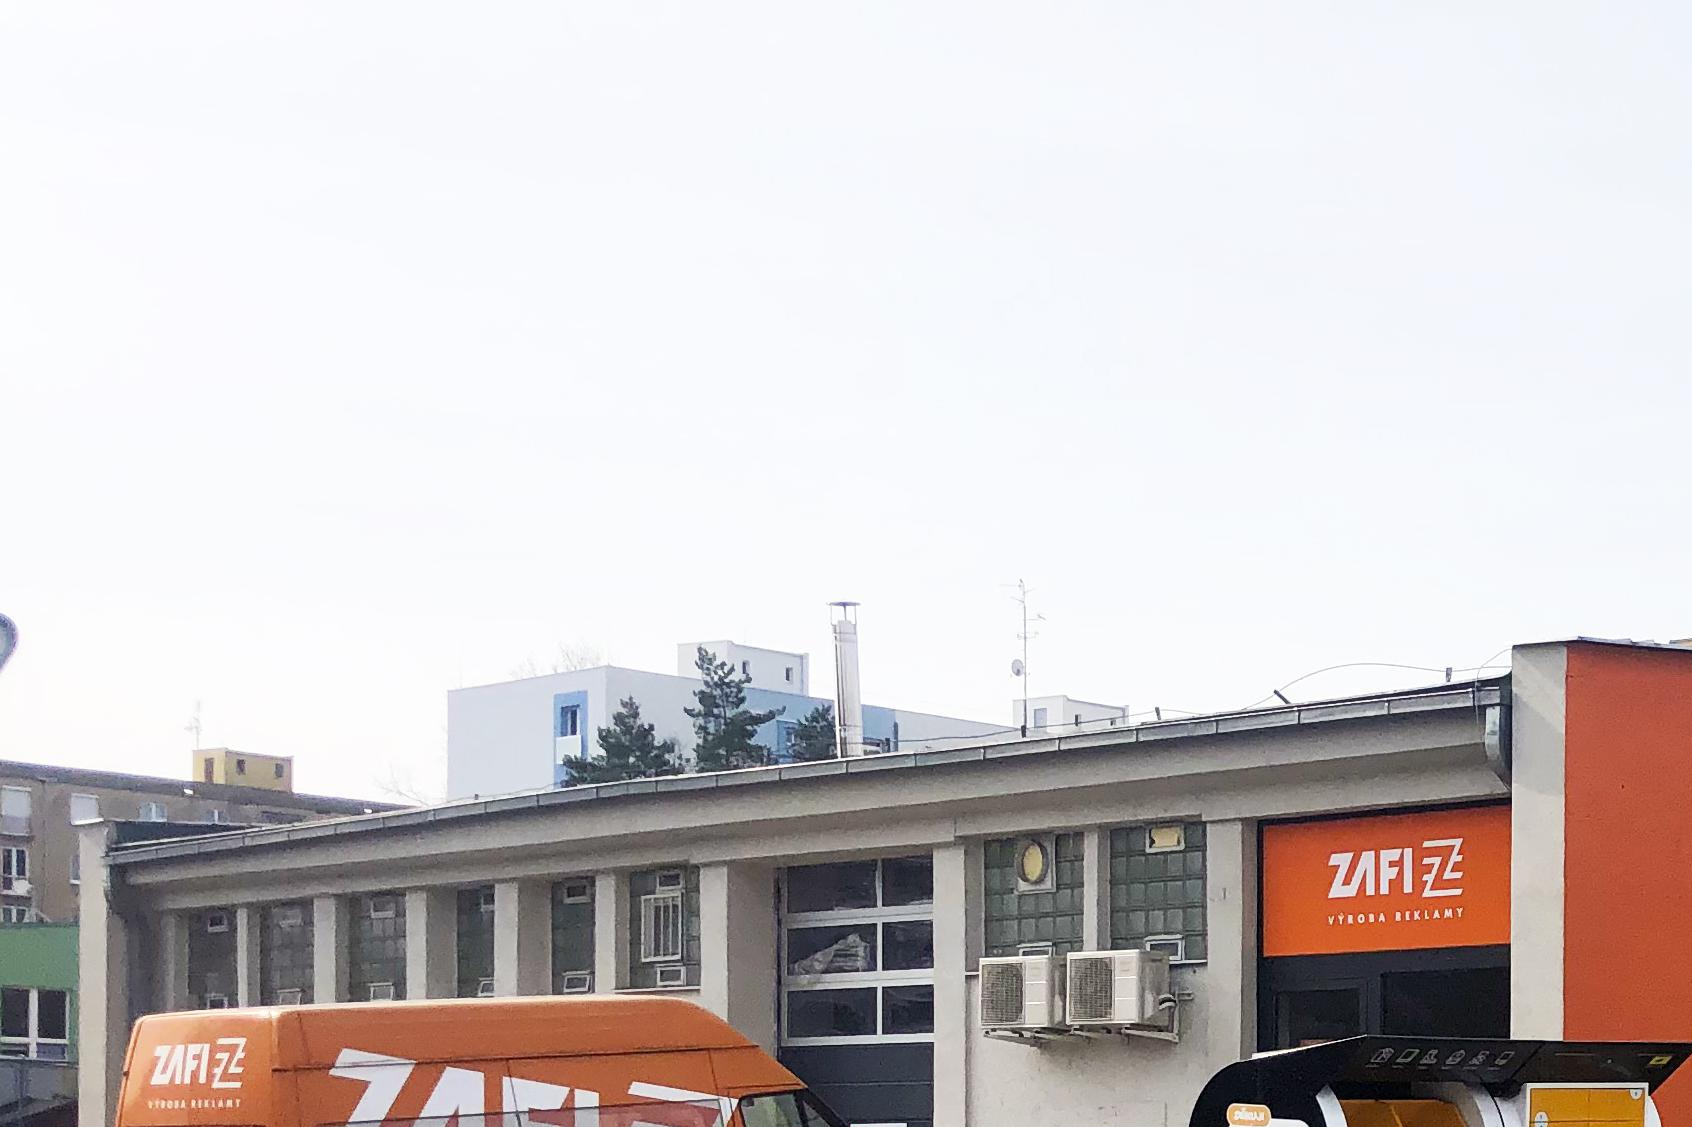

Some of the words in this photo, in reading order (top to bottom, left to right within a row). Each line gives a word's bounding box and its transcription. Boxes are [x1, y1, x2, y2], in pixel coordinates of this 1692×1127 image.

[1328, 847, 1413, 899] ZAFI
[1328, 912, 1386, 926] VÝROBA
[1395, 907, 1464, 922] REKLAMY
[150, 1043, 210, 1086] ZAFI
